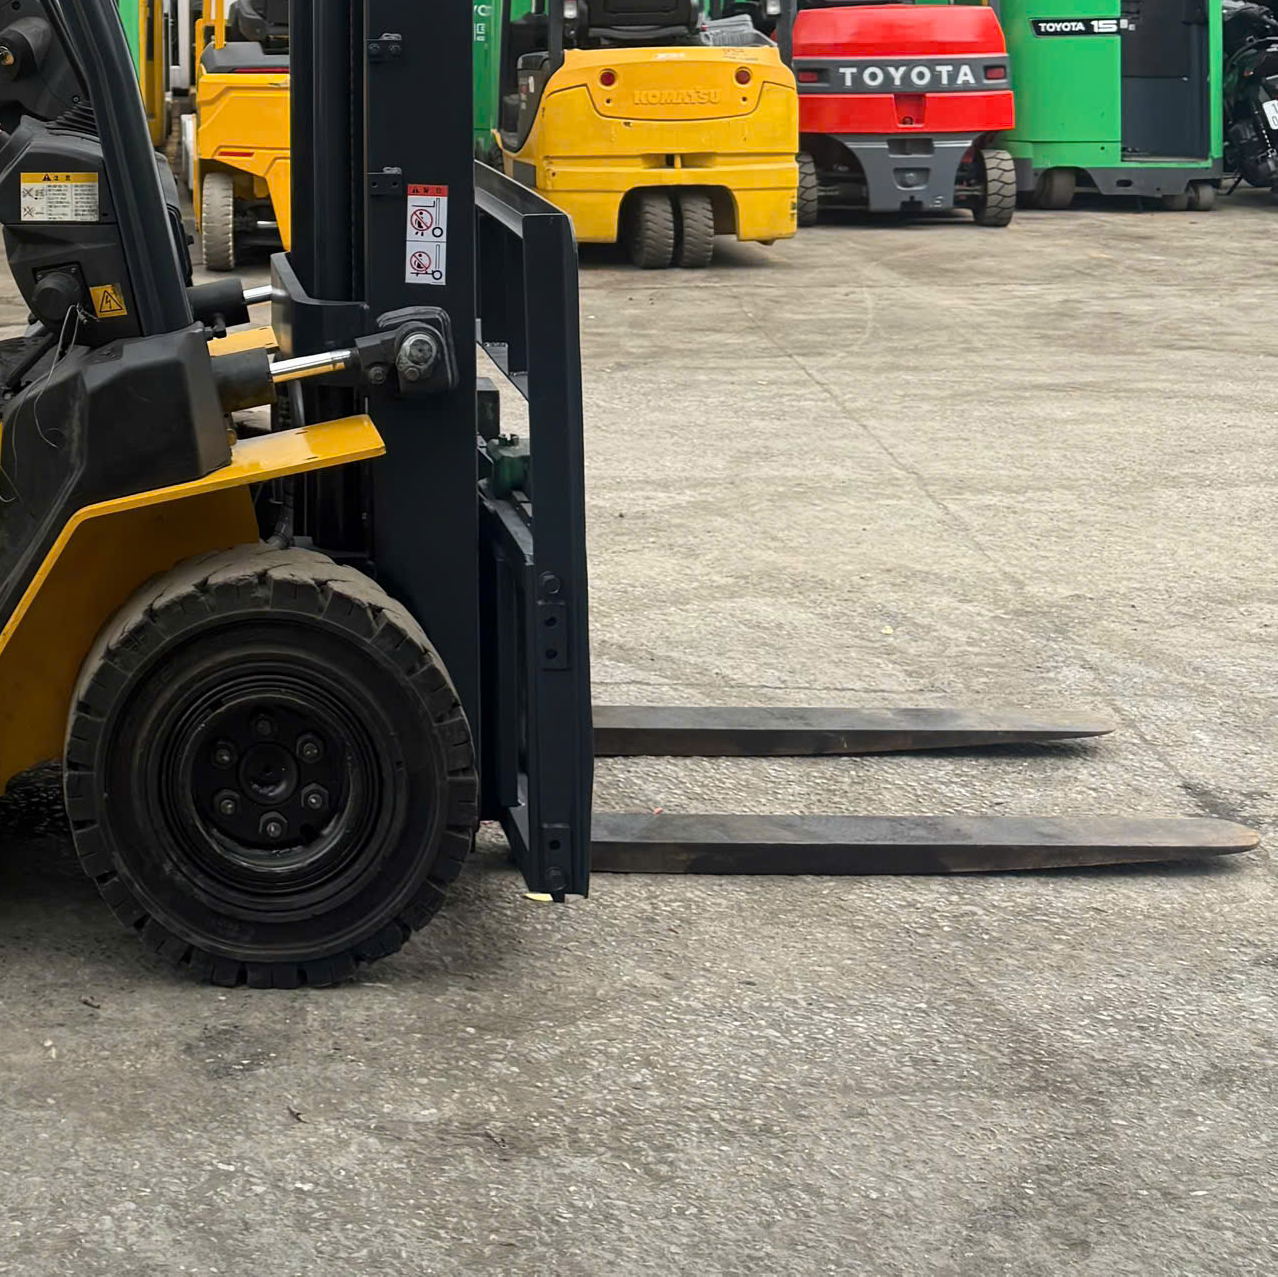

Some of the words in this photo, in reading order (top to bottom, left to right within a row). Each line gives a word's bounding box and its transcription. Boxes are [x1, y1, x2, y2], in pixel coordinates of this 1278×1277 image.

[1038, 21, 1085, 32] TOYOTA
[1090, 19, 1118, 33] 15
[839, 64, 976, 87] TOYOTA
[633, 88, 722, 106] KOMATSU
